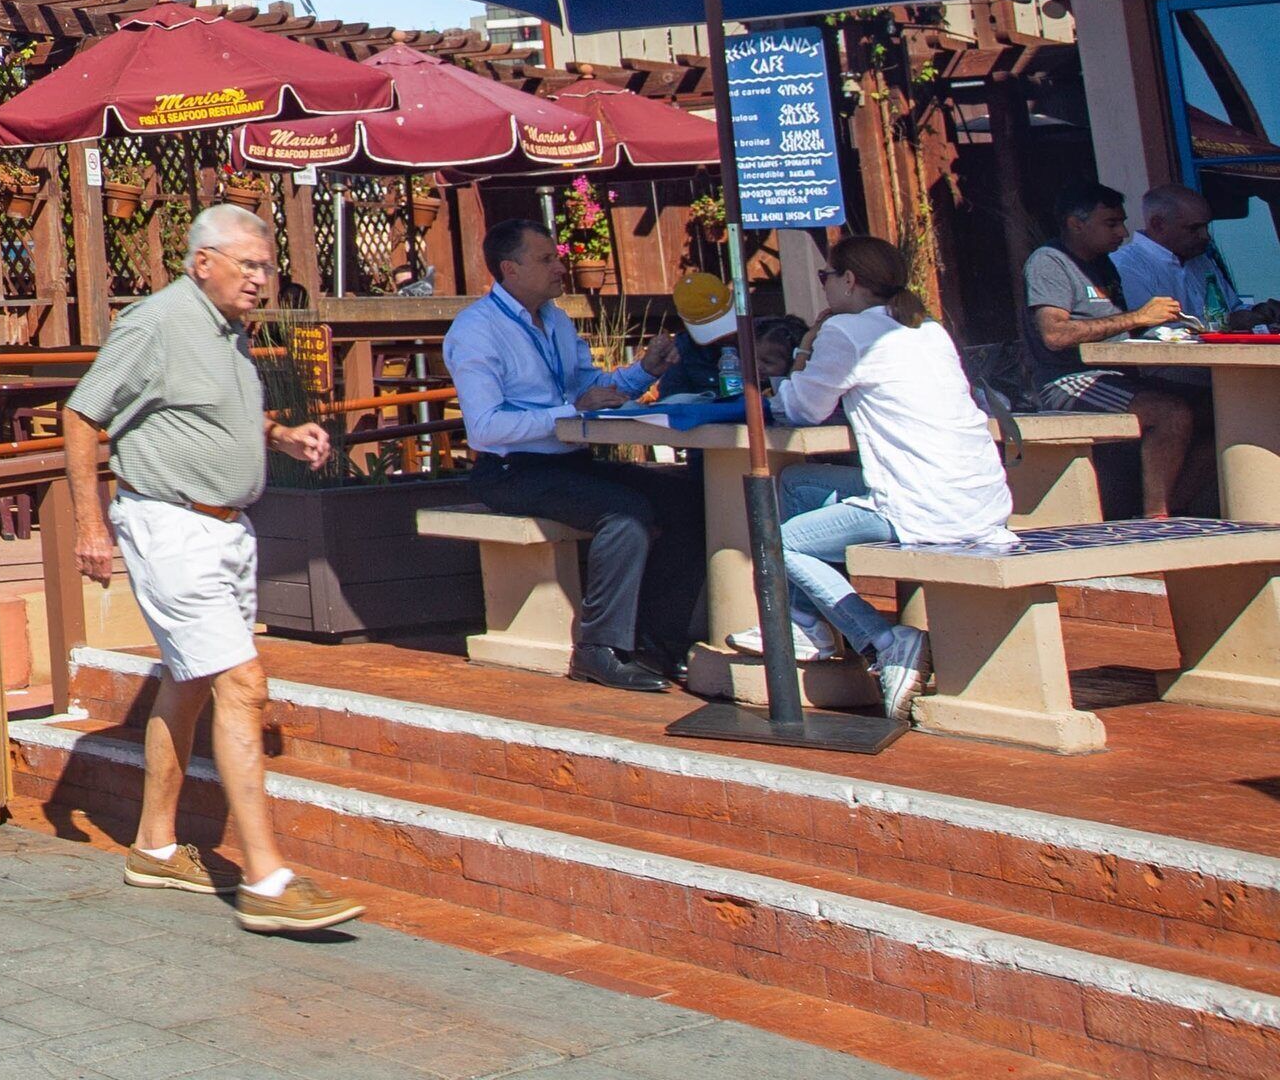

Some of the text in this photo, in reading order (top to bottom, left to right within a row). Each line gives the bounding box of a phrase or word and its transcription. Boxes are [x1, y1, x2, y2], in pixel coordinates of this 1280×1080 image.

[724, 35, 820, 64] REEK ISLANDS
[750, 55, 785, 75] CAFE
[741, 86, 771, 97] carved
[777, 82, 815, 97] GYROS
[139, 100, 264, 126] FISH & SEAFOOD RESTAURANT
[780, 101, 816, 116] GREEK
[778, 112, 820, 127] SALADS
[269, 127, 338, 147] Marion's
[524, 125, 577, 143] Marion's
[781, 129, 821, 141] LEMON
[249, 144, 351, 159] FISH & SEAFOOD RESTAURANT
[535, 145, 558, 156] SEAFOOD
[558, 141, 596, 156] RESTAURANT
[740, 138, 771, 148] broiled
[779, 138, 826, 153] CHICKEN
[785, 159, 810, 168] SPINACH
[743, 170, 785, 180] incredible
[740, 189, 774, 199] MPORTED
[774, 187, 797, 197] WINES
[804, 186, 829, 196] BEERS
[765, 197, 786, 206] MUCH
[787, 196, 809, 205] MORE
[741, 210, 812, 222] FULL MENU INSIDE
